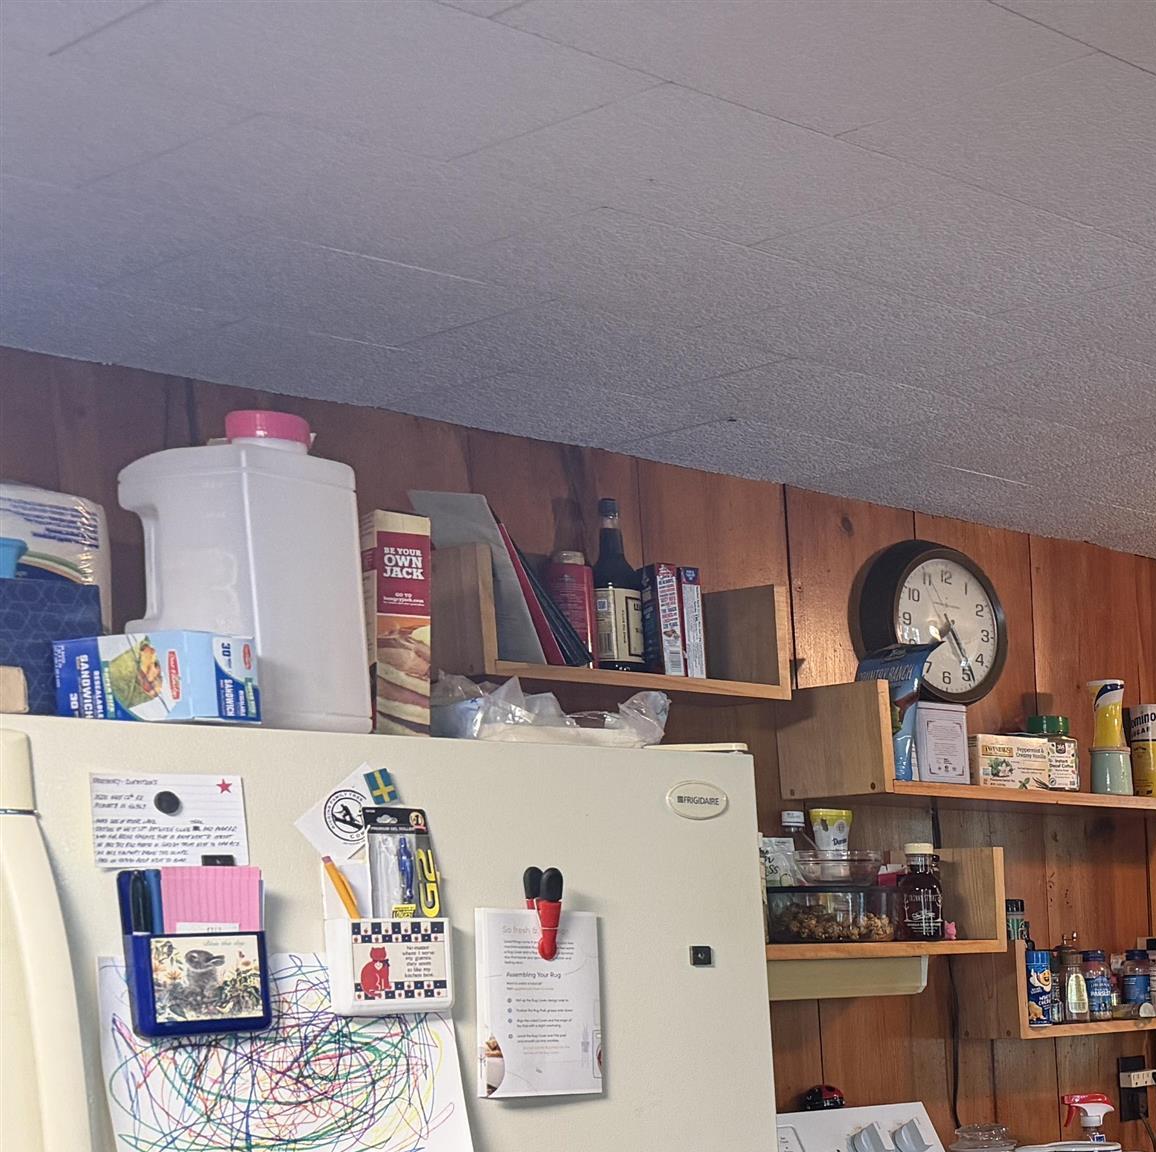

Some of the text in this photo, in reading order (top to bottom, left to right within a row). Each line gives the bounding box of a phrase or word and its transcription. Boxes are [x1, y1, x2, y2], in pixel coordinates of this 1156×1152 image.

[397, 548, 422, 556] YOUR
[384, 554, 423, 568] OWN
[383, 567, 425, 579] JACK
[922, 572, 932, 586] 11
[940, 570, 952, 585] 12
[908, 588, 920, 602] 10
[963, 582, 968, 595] 1
[975, 603, 984, 617] 2
[902, 611, 912, 625] 9
[981, 629, 990, 642] 3
[221, 642, 231, 657] 30
[975, 653, 984, 666] 4
[925, 661, 932, 674] 7
[942, 671, 952, 685] 6
[962, 668, 971, 682] 5
[79, 654, 94, 718] SANDWICH
[69, 693, 79, 709] 30
[93, 671, 104, 719] RESEALABLE
[224, 679, 235, 716] SANDWICH
[683, 796, 720, 805] FRIGIDAIRE
[417, 848, 440, 918] G2
